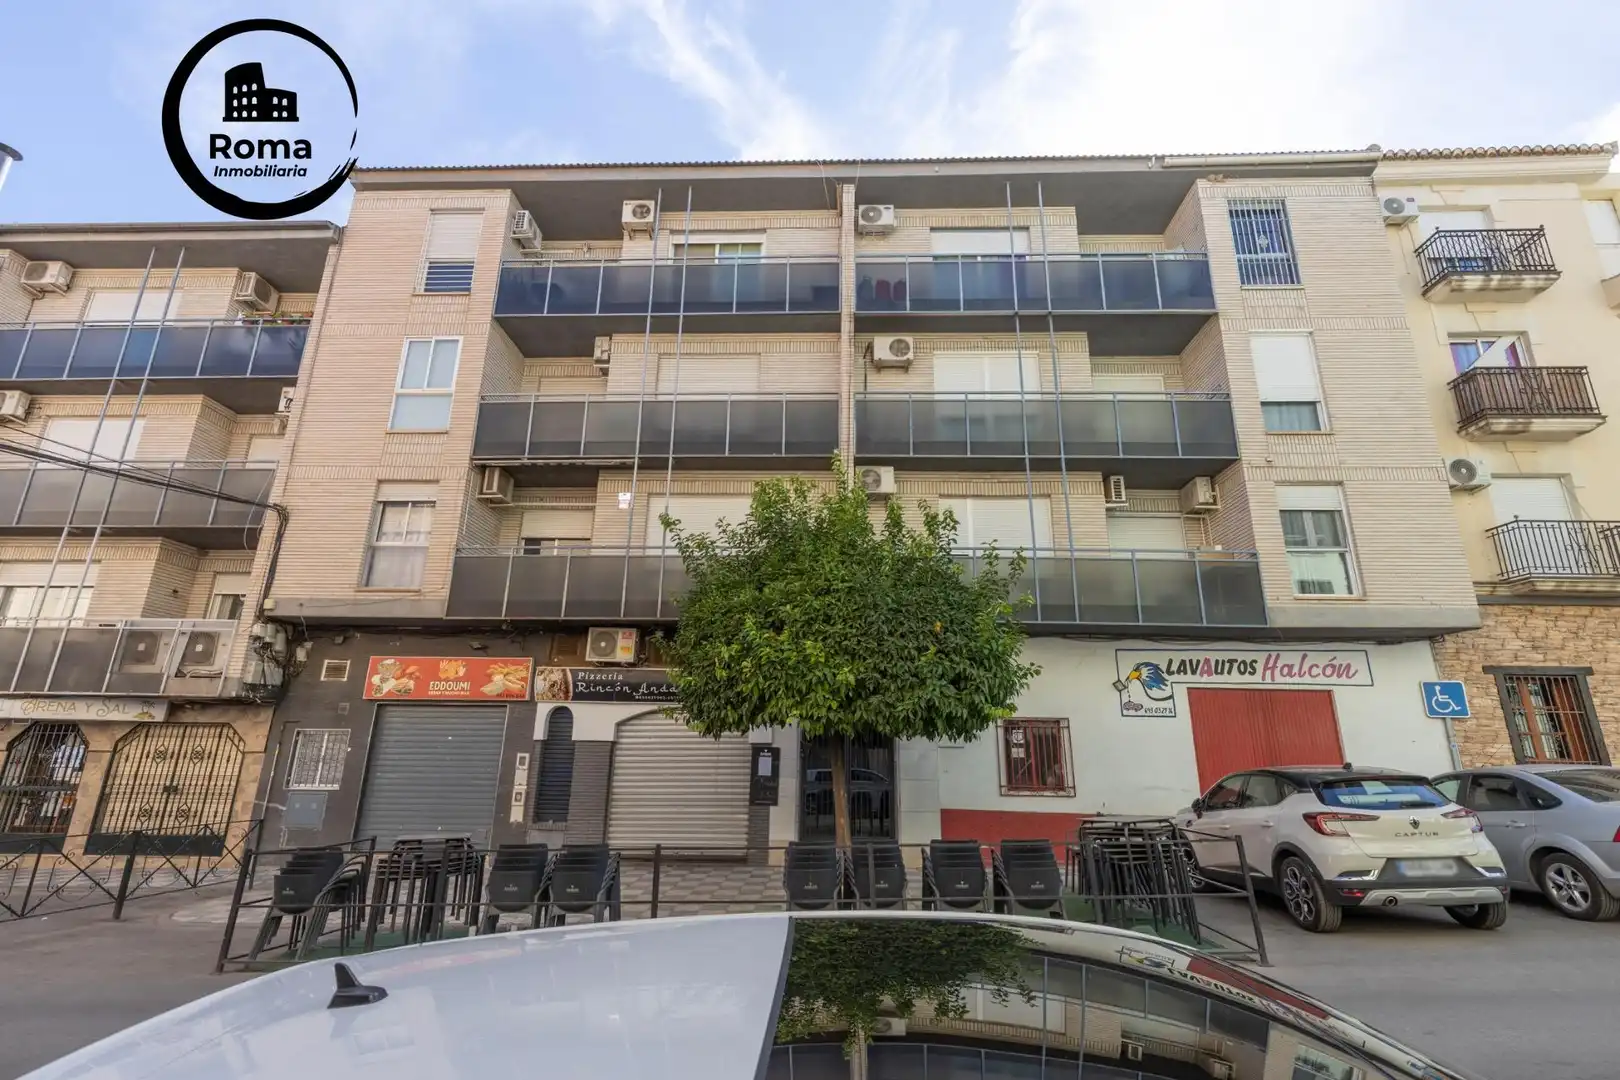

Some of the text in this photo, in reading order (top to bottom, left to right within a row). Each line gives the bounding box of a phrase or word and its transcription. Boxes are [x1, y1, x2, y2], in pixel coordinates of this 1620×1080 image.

[1261, 652, 1359, 683] Halcón
[429, 681, 471, 691] EDDOUMI
[575, 682, 632, 693] Rincón
[20, 698, 77, 715] ARENA
[84, 701, 94, 713] Y
[96, 698, 131, 717] SAL
